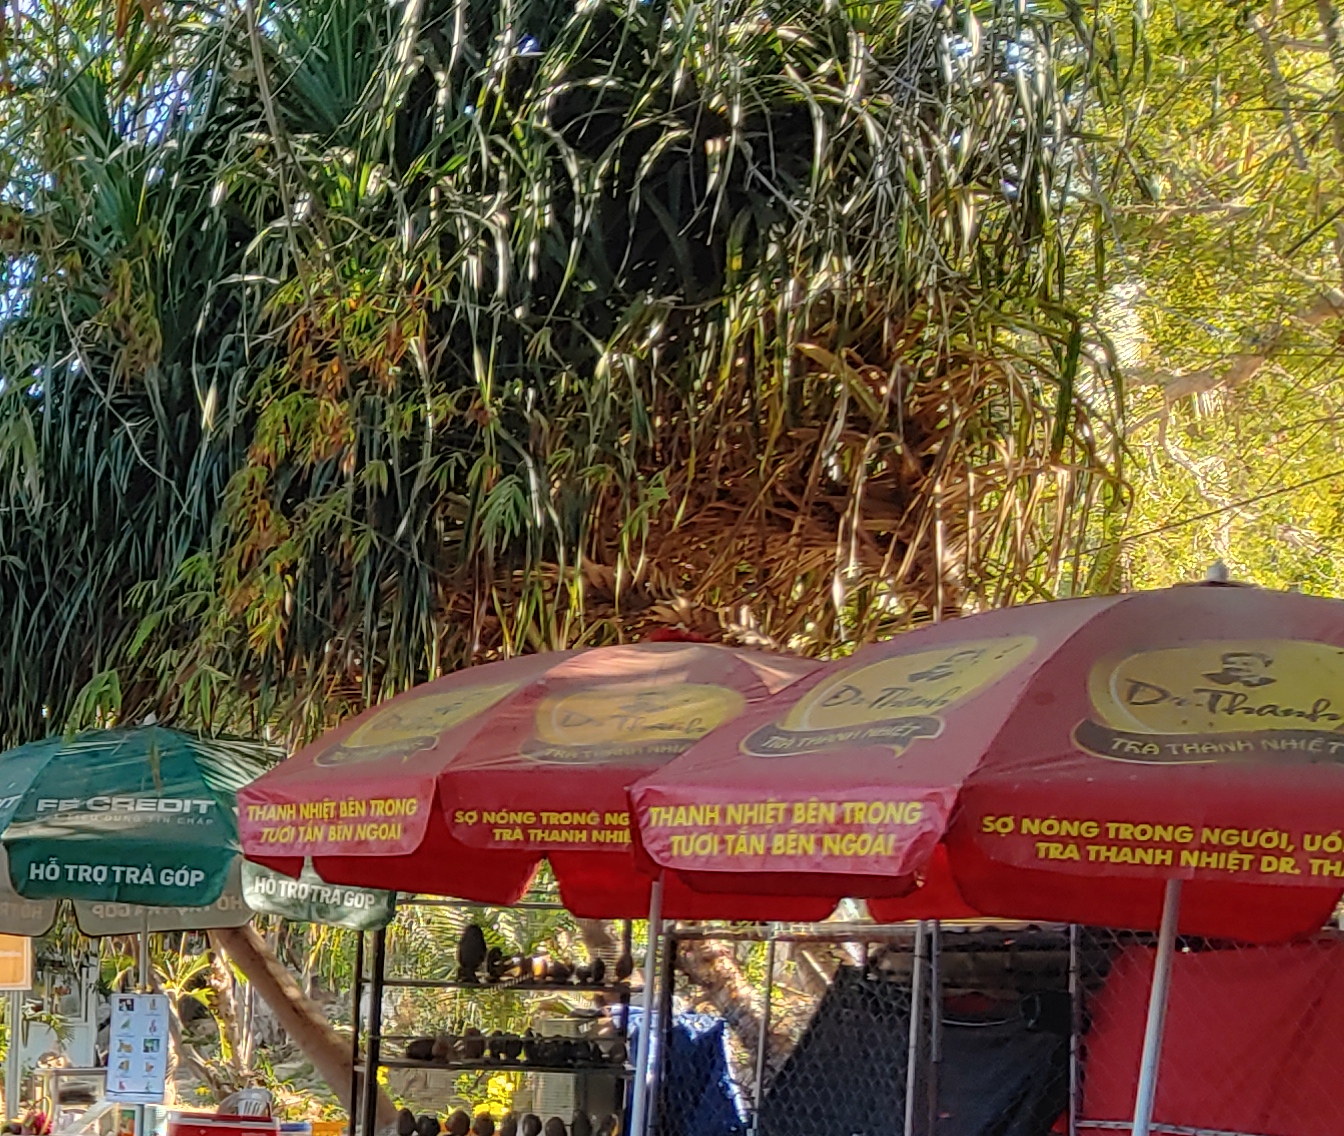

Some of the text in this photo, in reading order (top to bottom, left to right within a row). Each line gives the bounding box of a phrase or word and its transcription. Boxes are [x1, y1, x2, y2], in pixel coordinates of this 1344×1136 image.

[37, 797, 216, 814] FE CREDIT
[247, 803, 296, 822] THANH
[369, 798, 418, 818] TRONG
[454, 810, 478, 826] SỢ
[482, 808, 537, 825] NÓNG
[540, 811, 600, 826] TRONG
[649, 796, 924, 828] THANH NHIỆT BÊN TRONG
[493, 826, 524, 842] TRÀ
[527, 827, 588, 844] THANH
[771, 828, 814, 856] BÊN
[982, 814, 1015, 837] SỢ
[1020, 816, 1100, 838] NÓNG
[1106, 822, 1194, 843] TRONG
[1302, 828, 1344, 854] UỐ
[29, 857, 205, 888] HỖ TRỢ TRẢ GÓP
[1035, 840, 1344, 878] TRÀ THANH NHIỆT DR. THA
